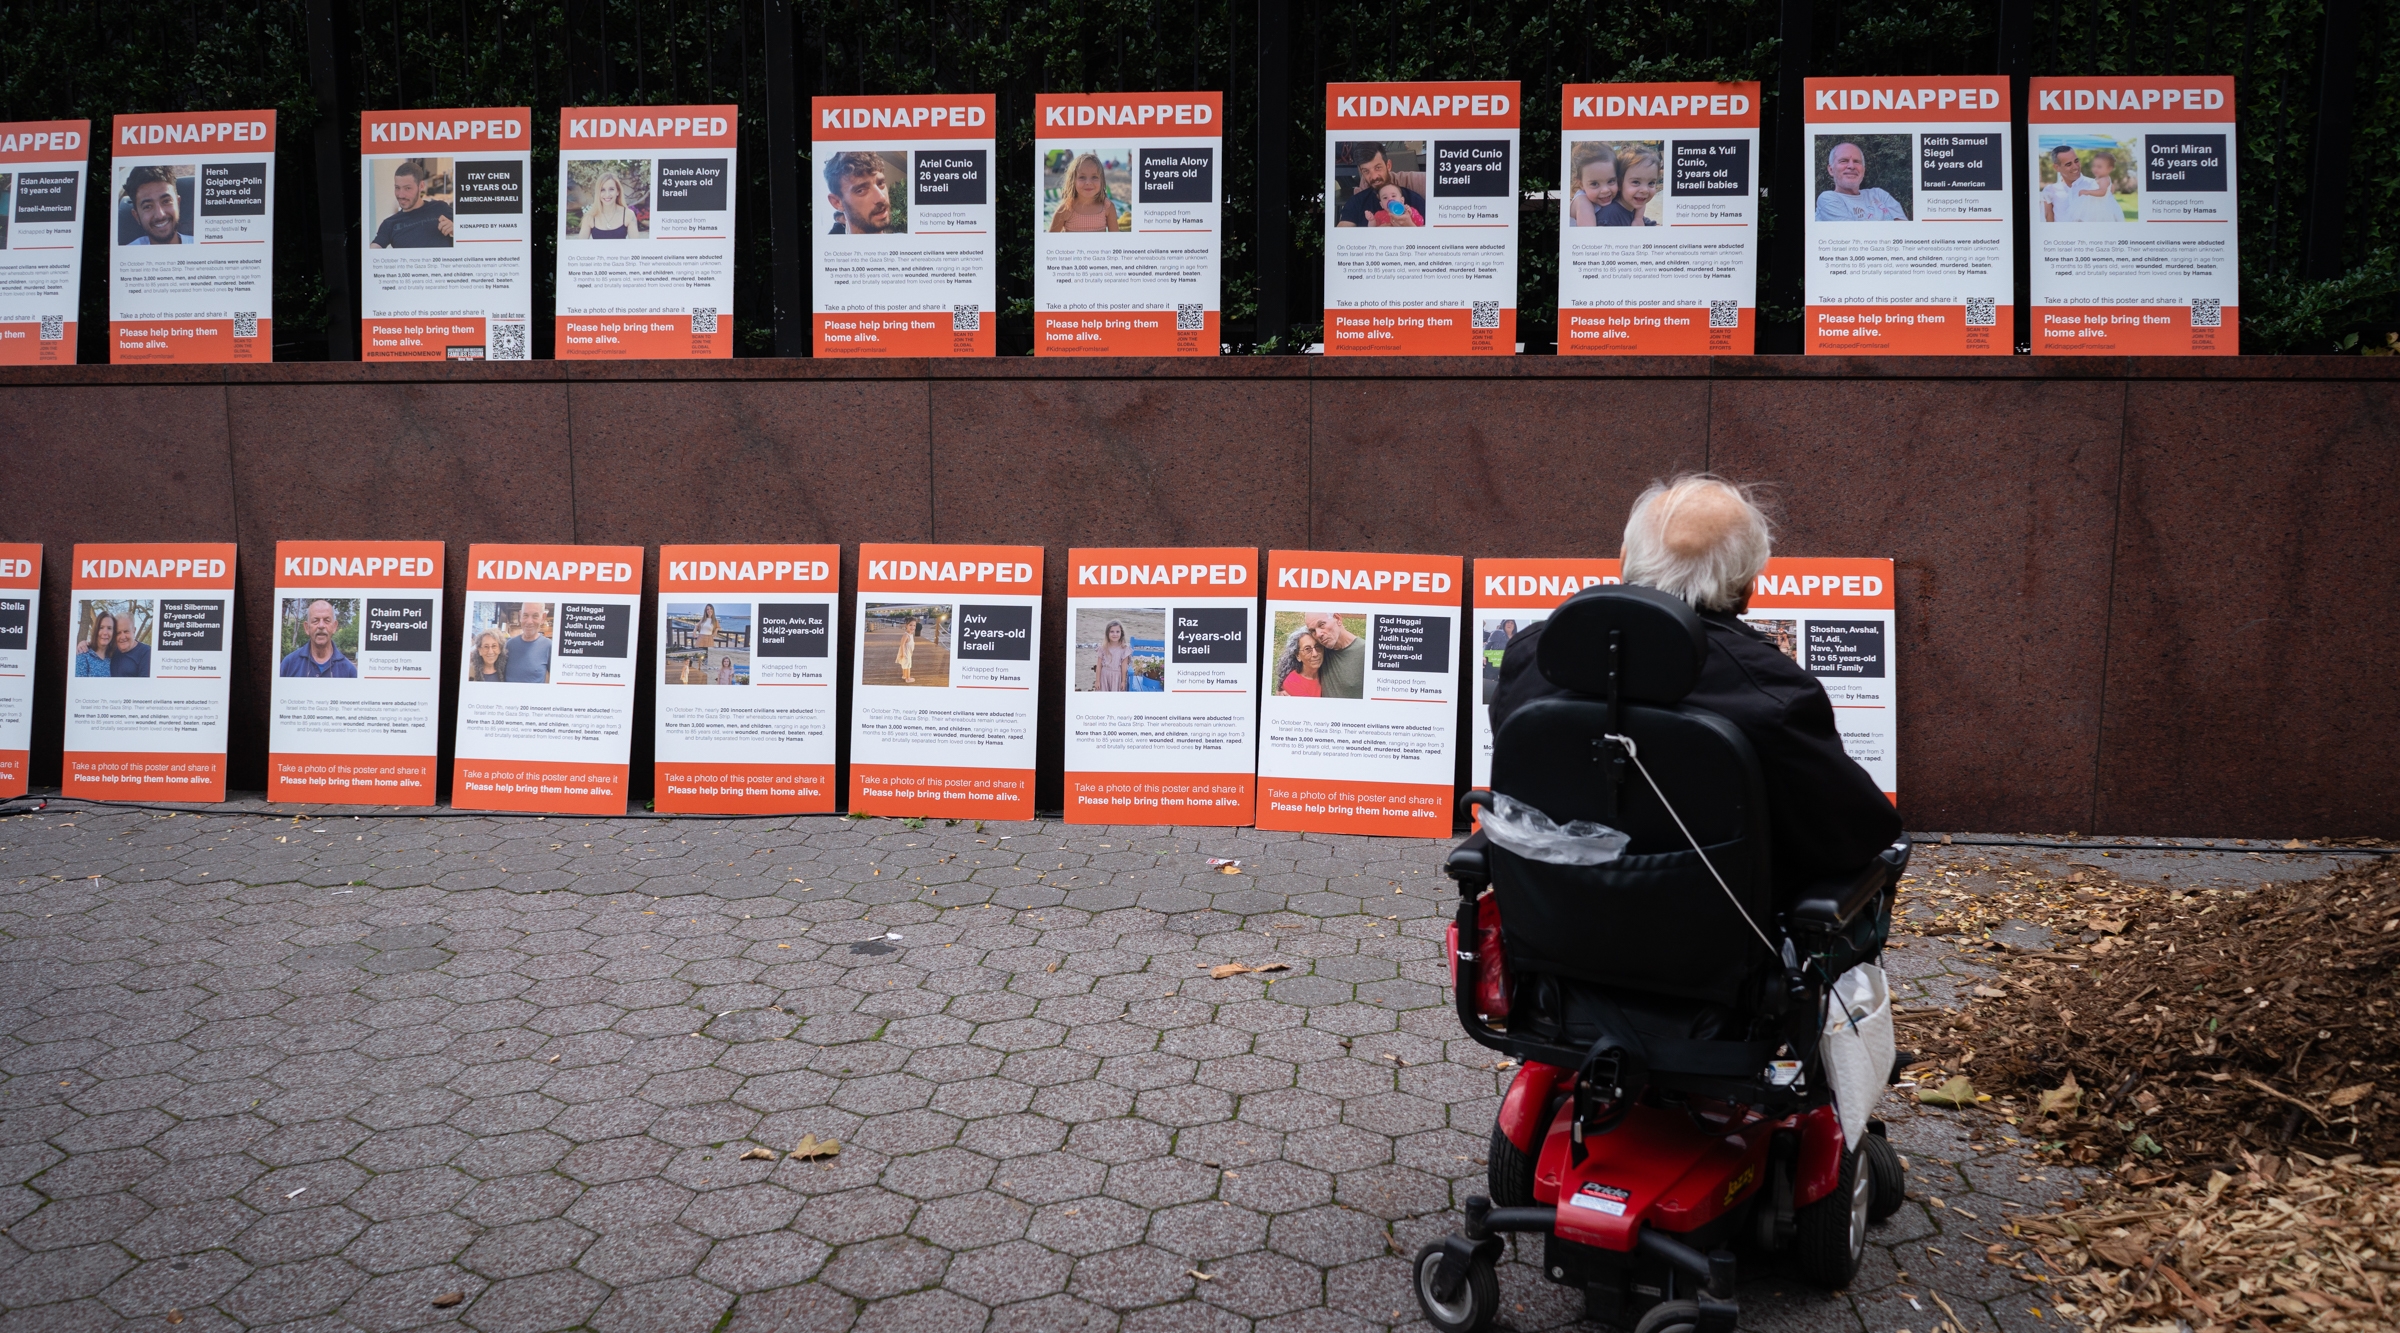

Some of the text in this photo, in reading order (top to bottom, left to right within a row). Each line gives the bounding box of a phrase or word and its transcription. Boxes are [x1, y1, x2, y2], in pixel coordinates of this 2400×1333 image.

[1815, 88, 2000, 111] KIDNAPPED
[2039, 88, 2224, 111] KIDNAPPED
[1337, 94, 1510, 118] KIDNAPPED
[1573, 94, 1750, 118] KIDNAPPED
[822, 106, 986, 129] KIDNAPPED
[1045, 104, 1213, 127] KIDNAPPED
[121, 121, 267, 145] KIDNAPPED
[371, 119, 522, 143] KIDNAPPED
[569, 117, 728, 139] KIDNAPPED
[1923, 136, 1988, 146] Keith Samuel
[1439, 148, 1503, 159] David Cunio
[1677, 146, 1736, 156] Emma & Yuli
[1923, 148, 1954, 159] Siegel
[2150, 144, 2212, 154] Omri Miran
[919, 158, 973, 168] Ariel Cunio
[1144, 156, 1209, 168] Amelia Alony
[1677, 157, 1708, 168] Cunio,
[1923, 159, 1983, 171] 64 years old
[2150, 157, 2219, 170] 46 years old
[206, 167, 229, 176] Hersh
[662, 167, 721, 177] Daniele Alony
[1439, 161, 1502, 174] 33 years old
[467, 172, 510, 180] ITAY CHEN
[919, 170, 978, 182] 26 years old
[1144, 168, 1198, 180] 5 years old
[1676, 169, 1728, 180] 3 years old
[2151, 170, 2186, 181] Israeli
[20, 176, 75, 185] Edan Alexander
[662, 178, 713, 188] 43 years old
[1439, 174, 1471, 185] Israeli
[1923, 180, 1946, 188] Israeli
[1951, 180, 1986, 188] American
[460, 183, 518, 192] 19 YEARS OLD
[919, 183, 949, 193] Israeli
[1144, 181, 1174, 191] Israeli
[1676, 180, 1739, 190] Israeli babies
[20, 186, 62, 196] 19 years old
[205, 187, 251, 198] 23 years old
[662, 188, 688, 197] Israeli
[205, 197, 262, 206] Israeli-American
[459, 195, 519, 203] AMERICAN-ISRAELI
[18, 204, 72, 213] Israeli-American
[81, 558, 226, 579] KIDNAPPED
[284, 557, 434, 577] KIDNAPPED
[477, 559, 632, 583] KIDNAPPED
[669, 561, 830, 581] KIDNAPPED
[868, 560, 1033, 583] KIDNAPPED
[1078, 564, 1247, 585] KIDNAPPED
[1278, 567, 1451, 593] KIDNAPPED
[1752, 574, 1883, 597] NAPPED
[0, 601, 25, 611] Stella
[164, 603, 219, 611] Yossi Silberman
[565, 605, 604, 615] Gad Haggai
[163, 612, 206, 621] 67-years-old
[370, 607, 422, 617] Chaim Peri
[565, 613, 606, 622] 73-years-old
[762, 617, 823, 626] Doron, Aviv, Raz
[963, 613, 988, 624] Aviv
[1178, 617, 1199, 627] Raz
[1379, 616, 1422, 627] Gad Haggai
[0, 625, 24, 634] s-old
[163, 621, 221, 630] Margit Silberman
[370, 620, 428, 632] 79-years-old
[584, 622, 605, 631] Lynne
[1379, 625, 1424, 635] 73-years-old
[1810, 625, 1879, 635] Shoshan, Avshal,
[162, 630, 205, 639] 63-years-old
[369, 632, 399, 642] Israeli
[564, 630, 597, 638] Weinstein
[963, 627, 1026, 640] 2-years-old
[1177, 630, 1242, 644] 4-years-old
[563, 638, 605, 647] 70-years-old
[762, 636, 785, 644] Israeli
[1400, 635, 1423, 644] Lynne
[1809, 634, 1843, 644] Tal, Adi,
[963, 640, 995, 651] Israeli
[1177, 644, 1210, 655] Israeli
[1378, 643, 1414, 652] Weinstein
[1810, 644, 1857, 653] Nave, Yahel
[563, 647, 584, 655] Israeli
[1377, 651, 1423, 661] 70-years-old
[1810, 654, 1877, 664] 3 to 65 years-old
[1377, 660, 1400, 669] Israeli
[1810, 663, 1864, 673] Israeli Family
[1270, 801, 1437, 818] Please help bring them home alive.
[1723, 1163, 1755, 1206] Jazzy
[1583, 1182, 1630, 1198] Pride
